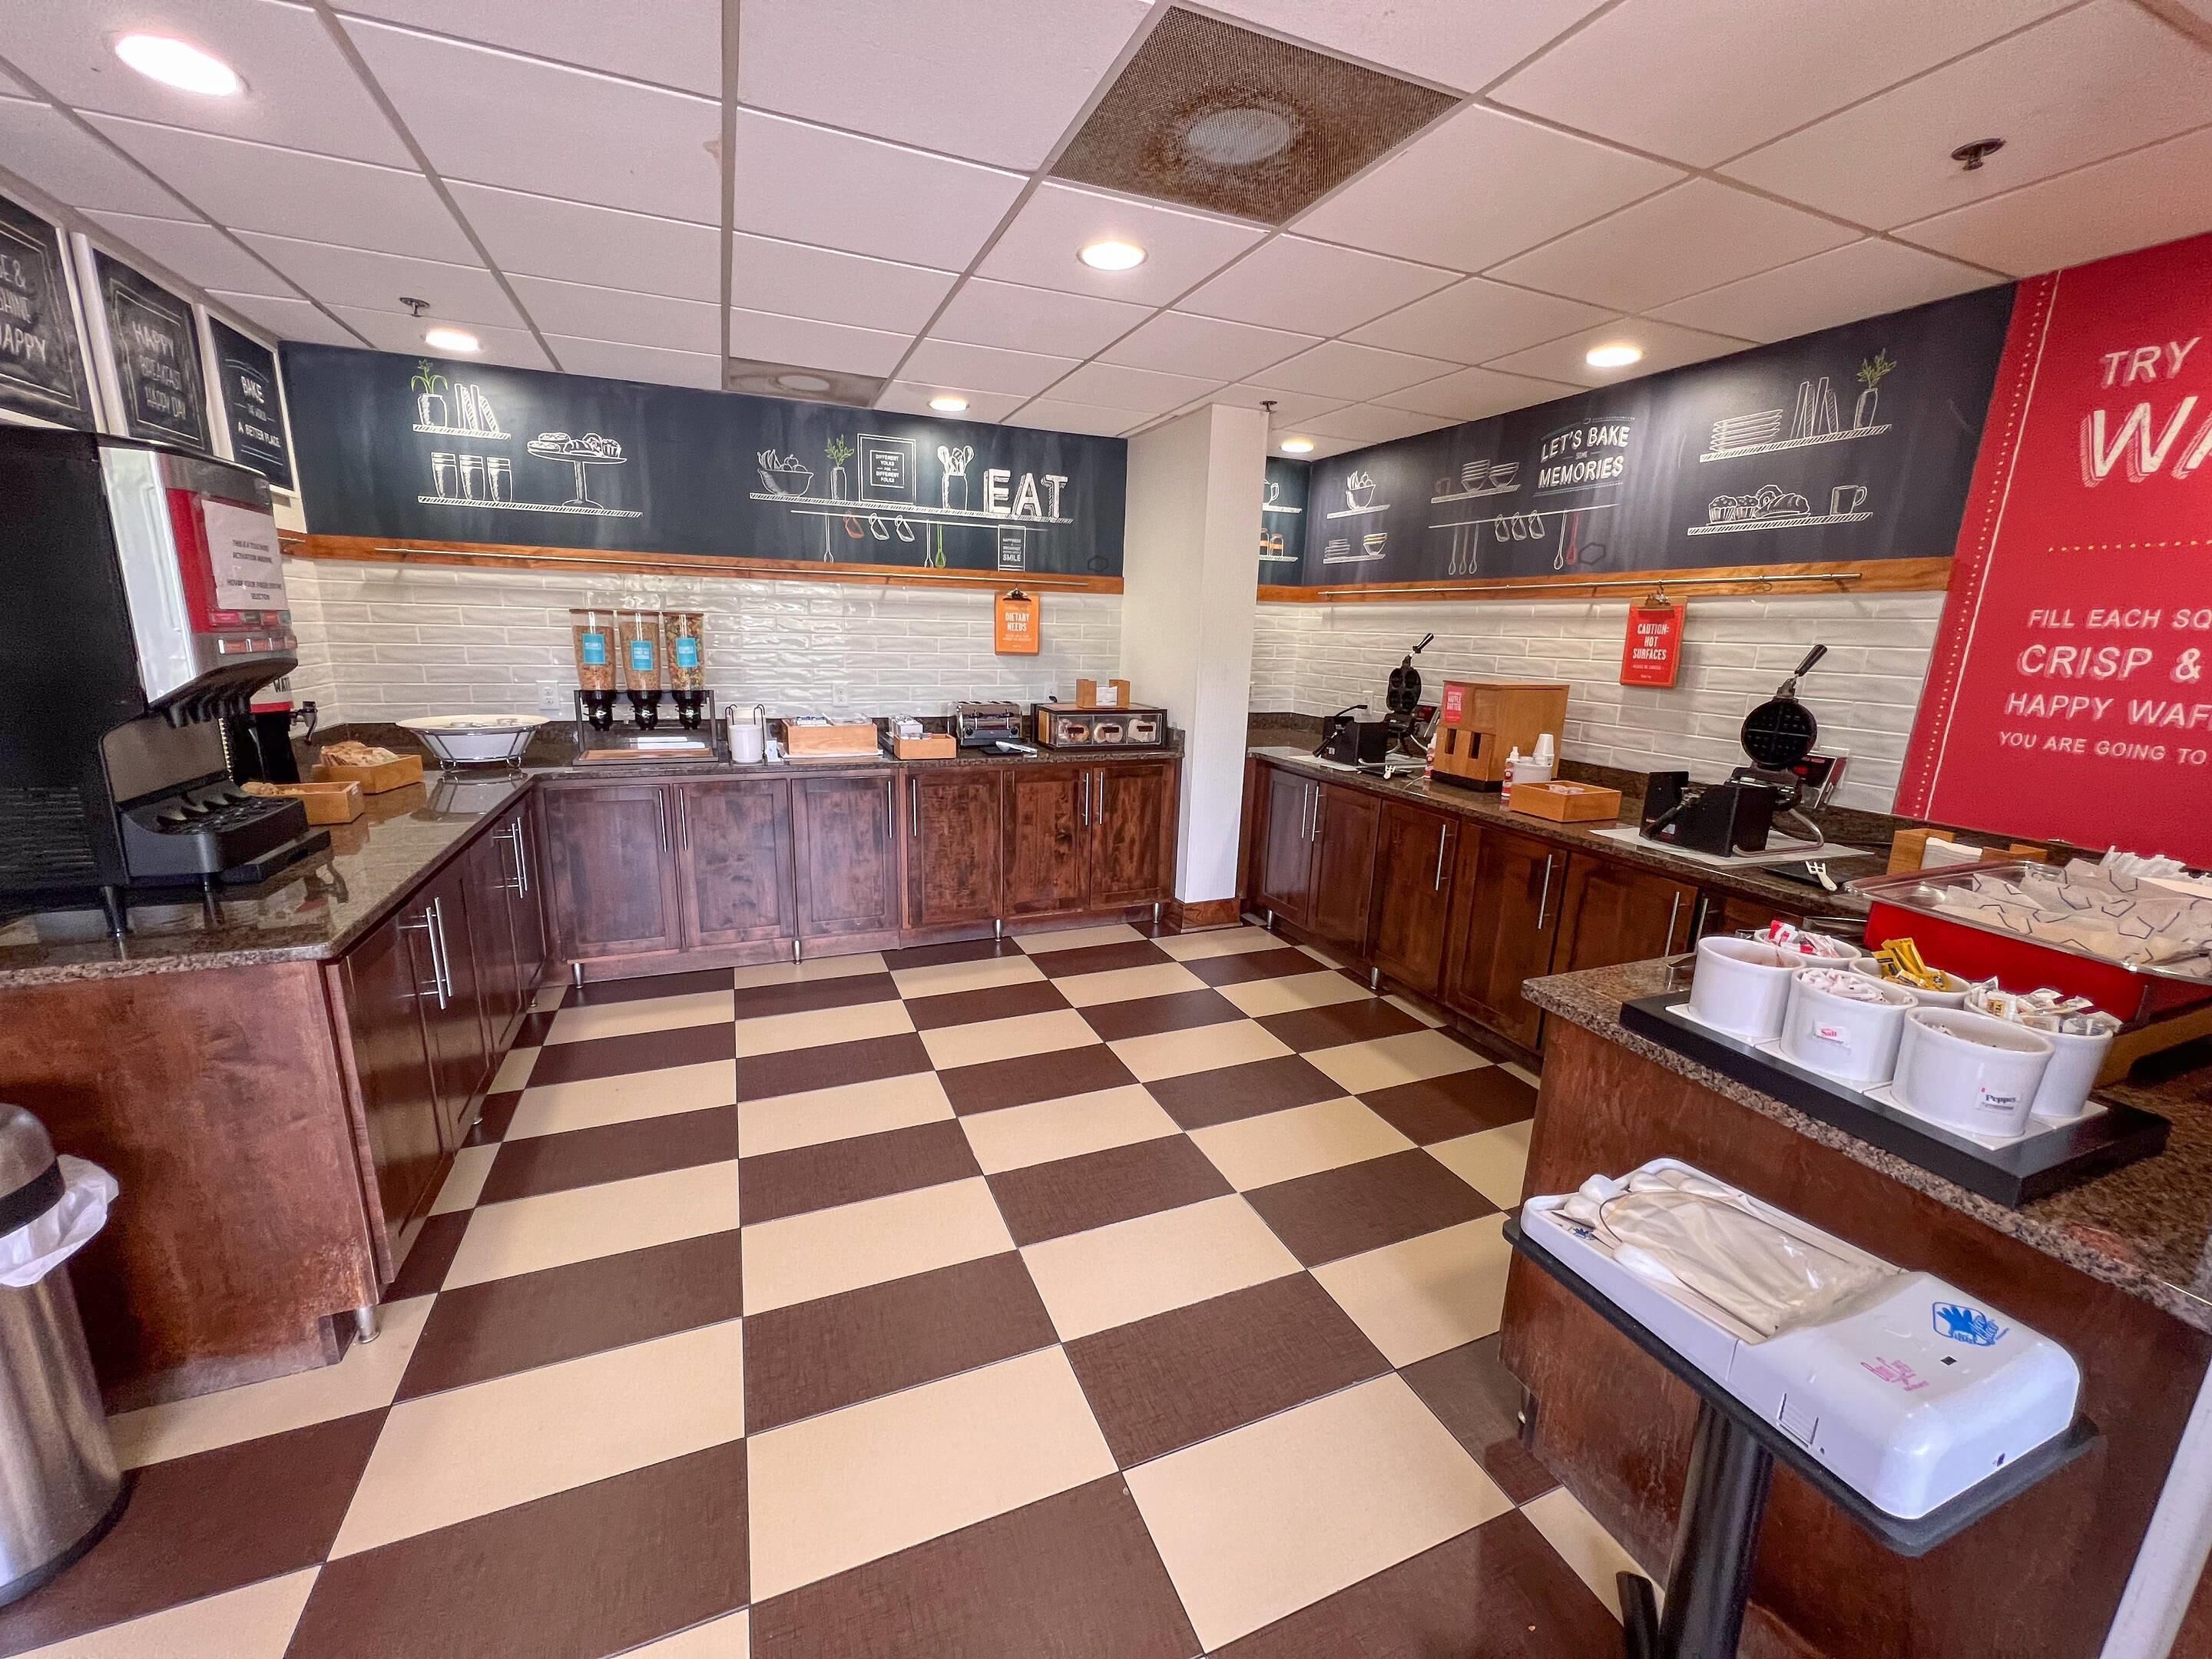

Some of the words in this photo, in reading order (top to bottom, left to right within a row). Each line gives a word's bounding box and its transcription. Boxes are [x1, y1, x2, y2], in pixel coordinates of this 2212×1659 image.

[132, 321, 174, 358] HAPPY
[139, 354, 182, 391] BREAKFAST
[2101, 336, 2203, 388] TRY
[240, 376, 265, 403] BAKE
[238, 421, 244, 435] A
[1541, 429, 1582, 463] LET'S
[1587, 424, 1631, 448] BAKE
[1538, 455, 1624, 488] MEMORIES
[984, 468, 1068, 518] EAT
[1002, 553, 1022, 562] SMILE
[1005, 611, 1031, 622] DIETARY
[1007, 621, 1027, 632] NEEDS
[1637, 623, 1670, 636] CAUTION:
[2028, 608, 2075, 629] FILL
[2086, 608, 2162, 629] EACH
[1632, 648, 1667, 661] SURFACES
[1644, 636, 1659, 648] HOT
[2017, 644, 2153, 681] CRISP
[2170, 647, 2202, 684] &
[2004, 692, 2114, 721] HAPPY
[1999, 730, 2038, 749] YOU
[2042, 735, 2088, 753] ARE
[2094, 740, 2166, 760] GOING
[2177, 747, 2207, 766] TO
[1820, 1028, 1837, 1038] Salt
